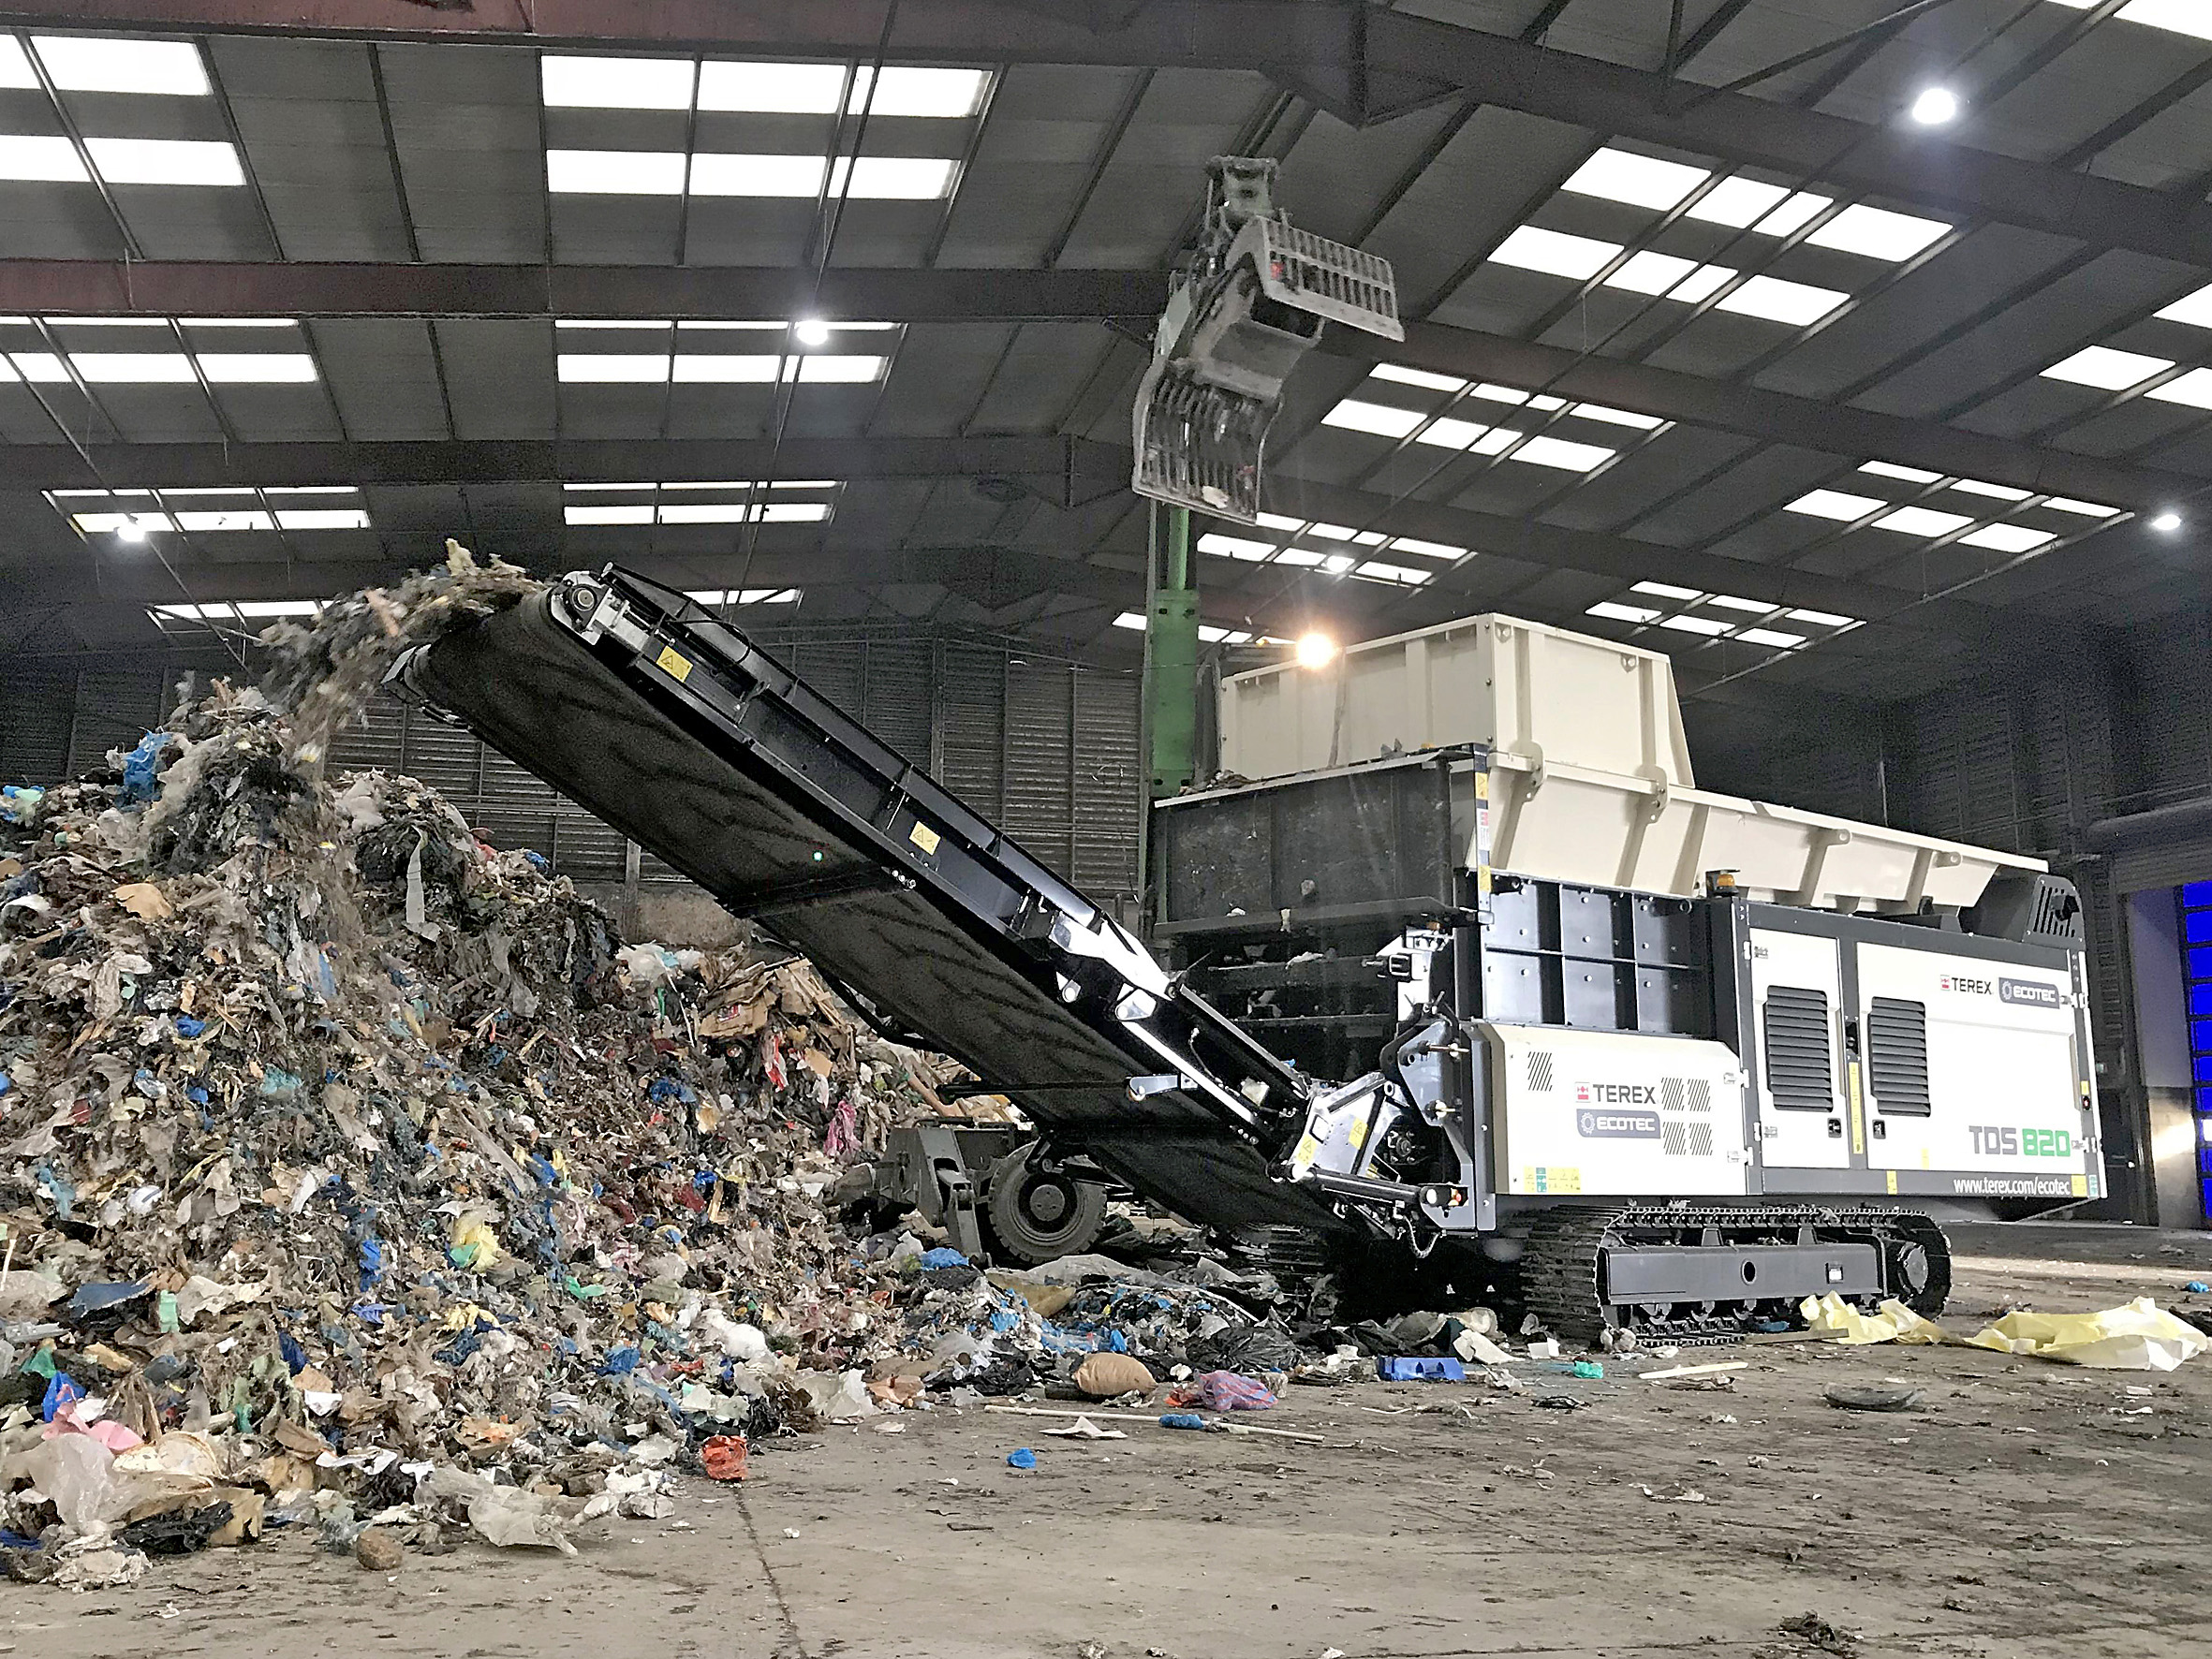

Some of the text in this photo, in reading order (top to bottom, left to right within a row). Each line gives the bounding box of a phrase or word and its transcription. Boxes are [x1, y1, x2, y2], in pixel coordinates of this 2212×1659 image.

[1952, 977, 2056, 1003] TEREX ECOTEC
[1592, 1083, 1656, 1104] TEREX
[1596, 1116, 1655, 1131] ECOTEC
[1969, 1125, 2071, 1156] TDS 820
[1954, 1176, 2071, 1195] www.terex.com/ecotec
